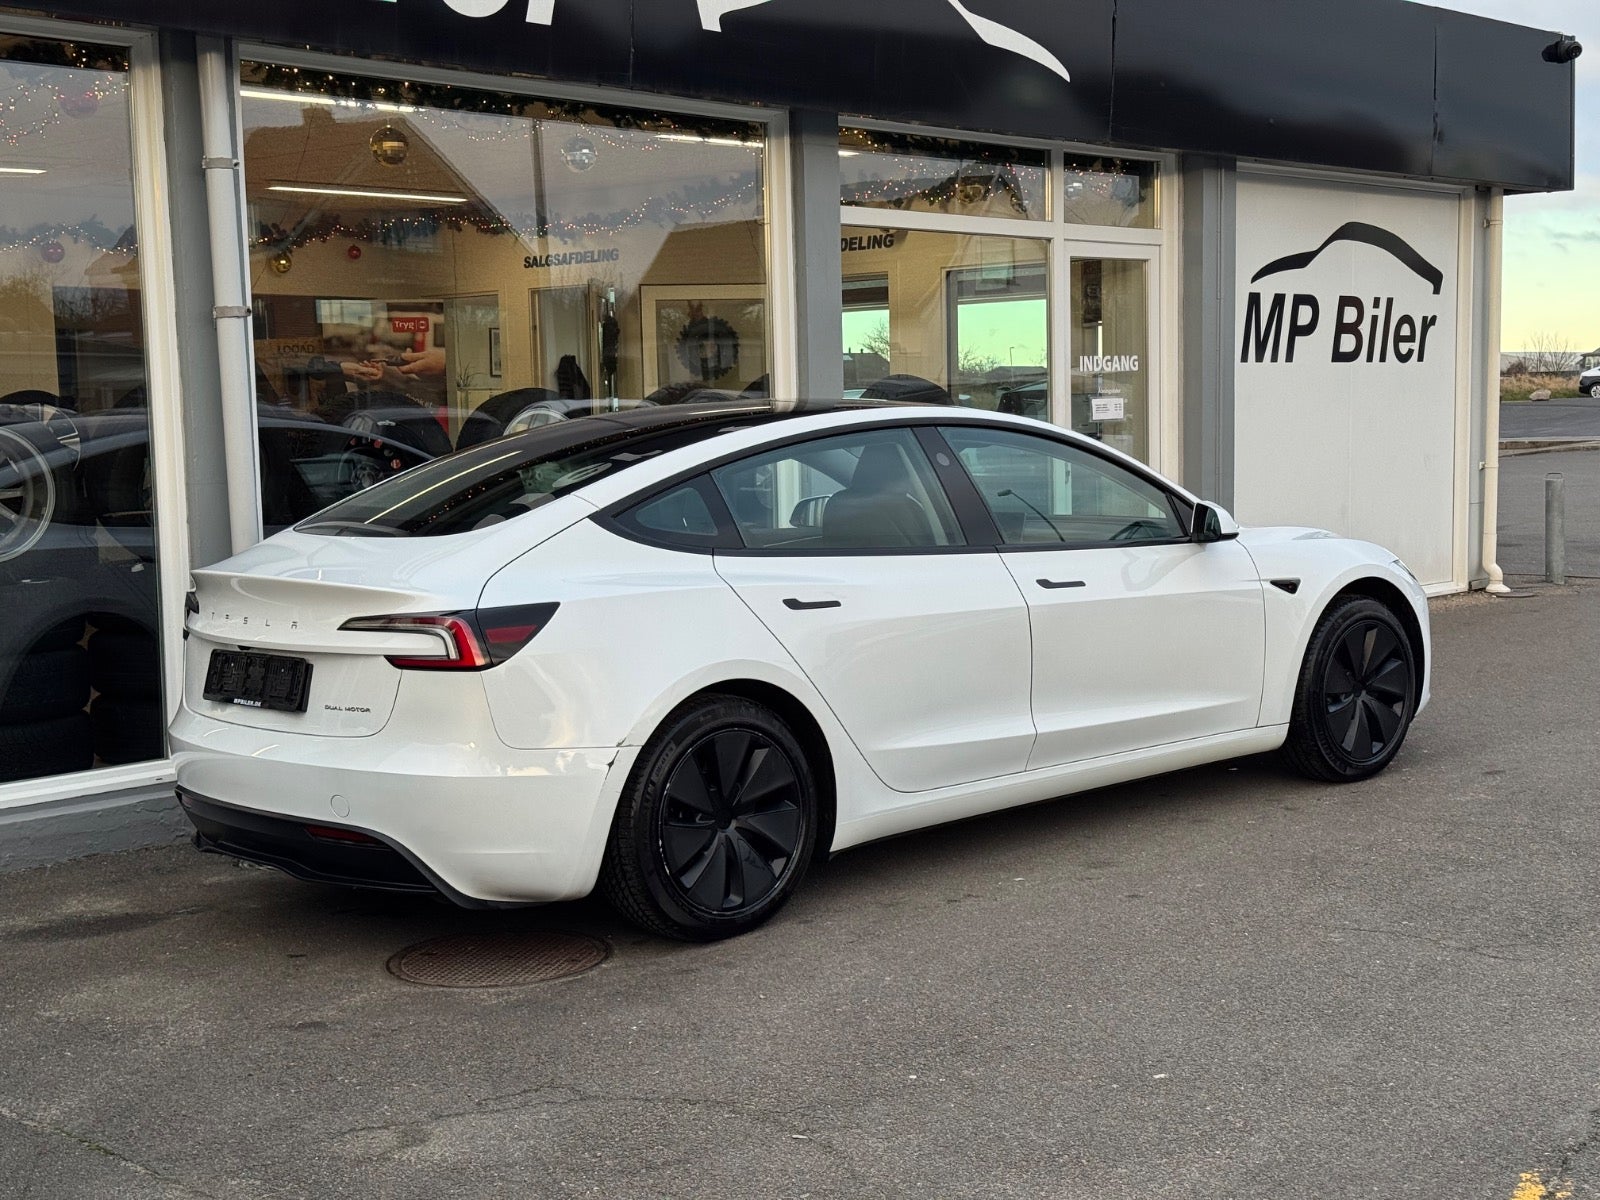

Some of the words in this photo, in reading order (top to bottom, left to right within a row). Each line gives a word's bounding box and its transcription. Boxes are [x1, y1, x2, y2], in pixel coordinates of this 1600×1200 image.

[523, 248, 620, 269] SALGSAFDELING
[394, 320, 415, 330] Tryg
[1240, 292, 1320, 363] MP
[1331, 295, 1438, 364] Biler
[1079, 355, 1139, 372] INDGANG
[324, 704, 343, 712] DUAL
